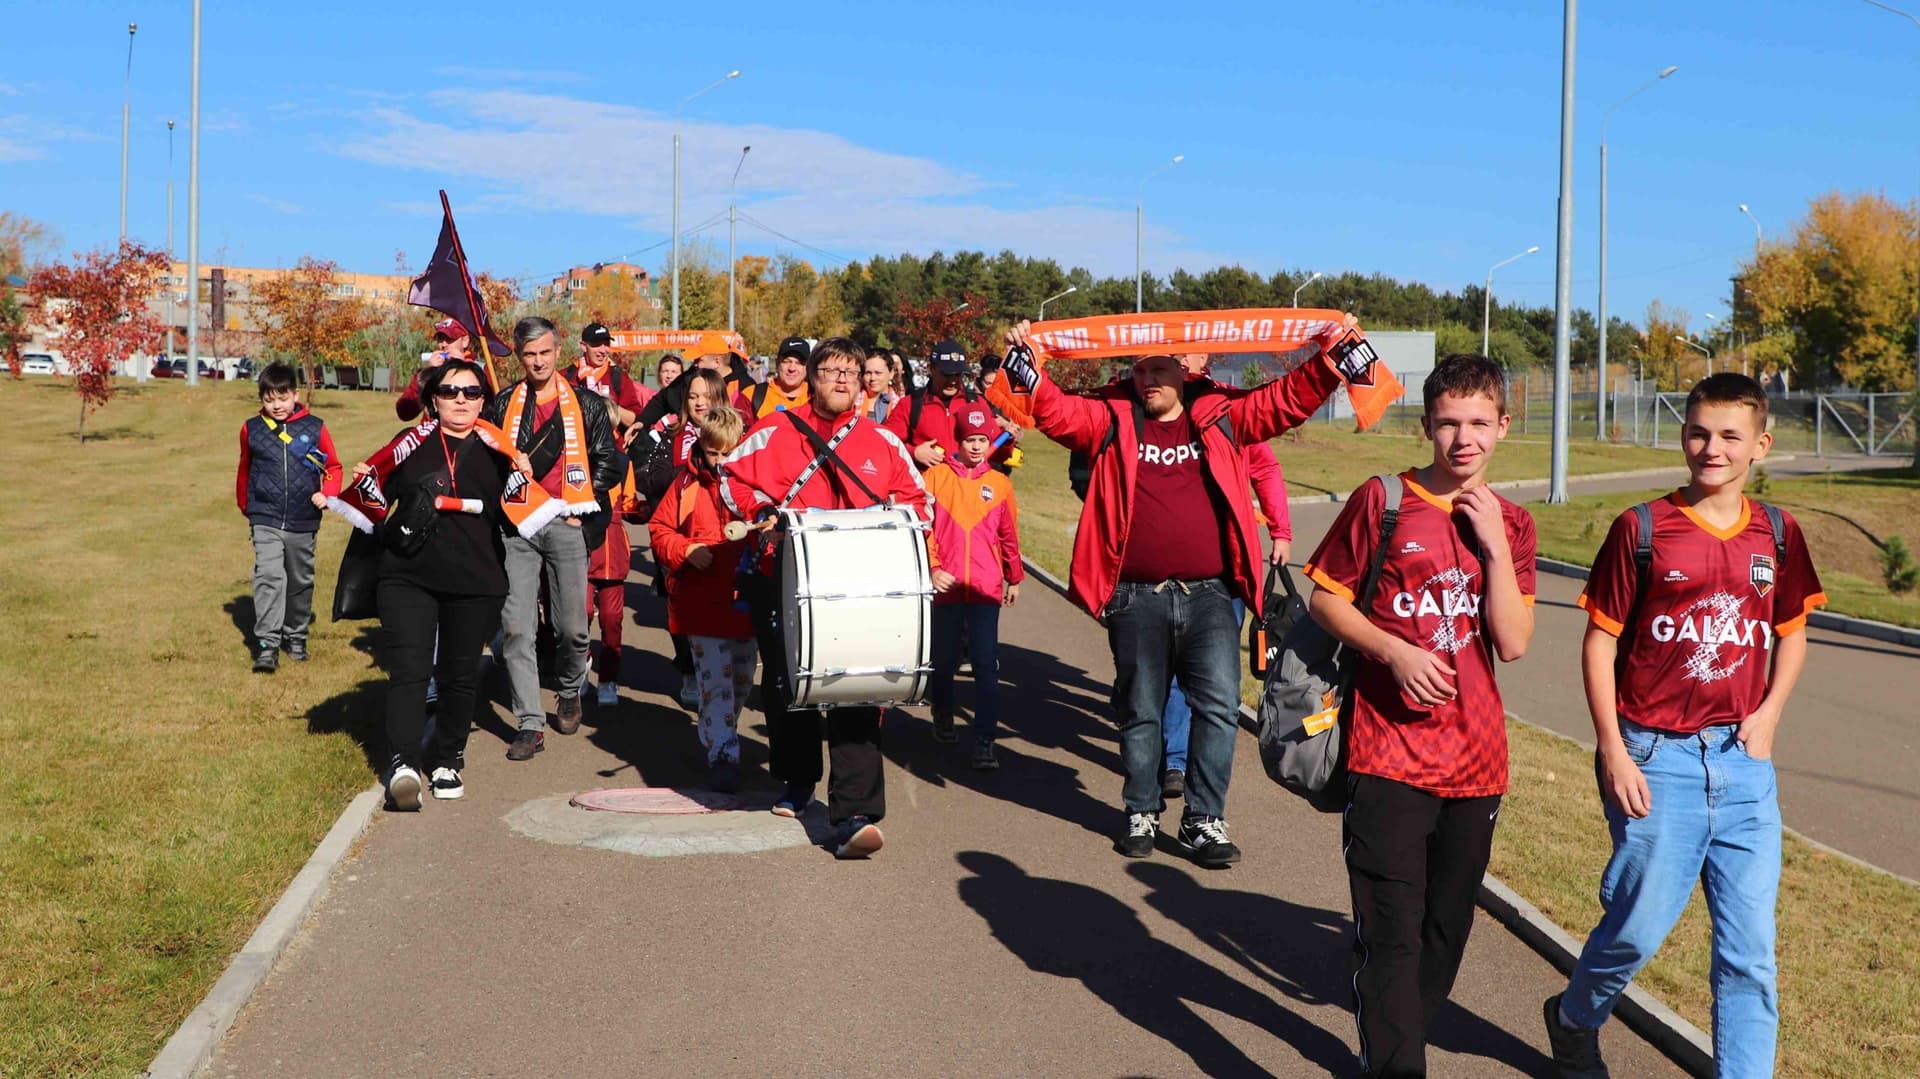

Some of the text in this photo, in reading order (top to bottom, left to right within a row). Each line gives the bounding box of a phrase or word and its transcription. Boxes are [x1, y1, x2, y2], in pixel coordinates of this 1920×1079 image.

[1030, 327, 1099, 353] ТЕМП,
[1106, 322, 1173, 347] ТЕМП,
[1184, 319, 1273, 342] ТОЛЬКО
[1651, 614, 1772, 649] GALAXY
